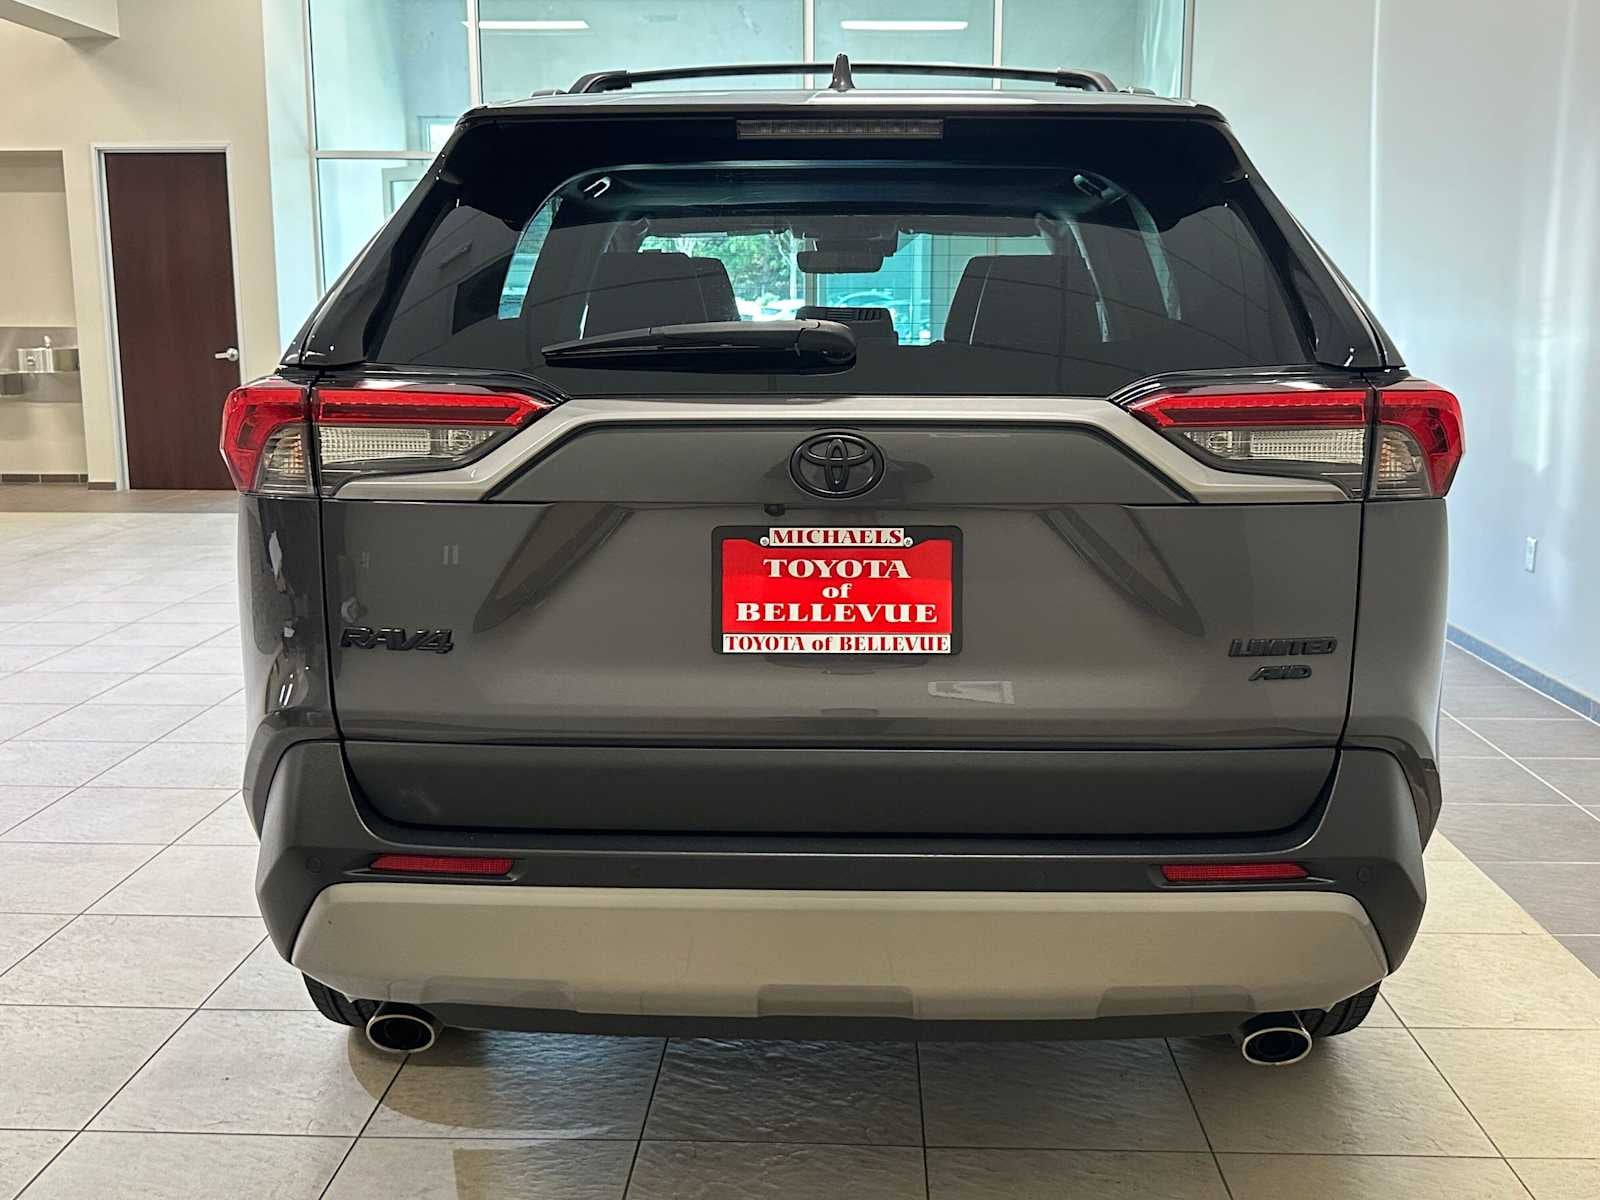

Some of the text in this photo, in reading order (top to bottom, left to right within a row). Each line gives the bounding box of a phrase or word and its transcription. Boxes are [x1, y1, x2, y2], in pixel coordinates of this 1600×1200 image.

[773, 529, 901, 544] MICHAELS
[763, 559, 911, 579] TOYOTA
[822, 583, 852, 599] of
[736, 602, 938, 623] BELLEVUE
[341, 627, 454, 654] RAV4
[725, 636, 949, 651] TOYOTA of BELLEVUE
